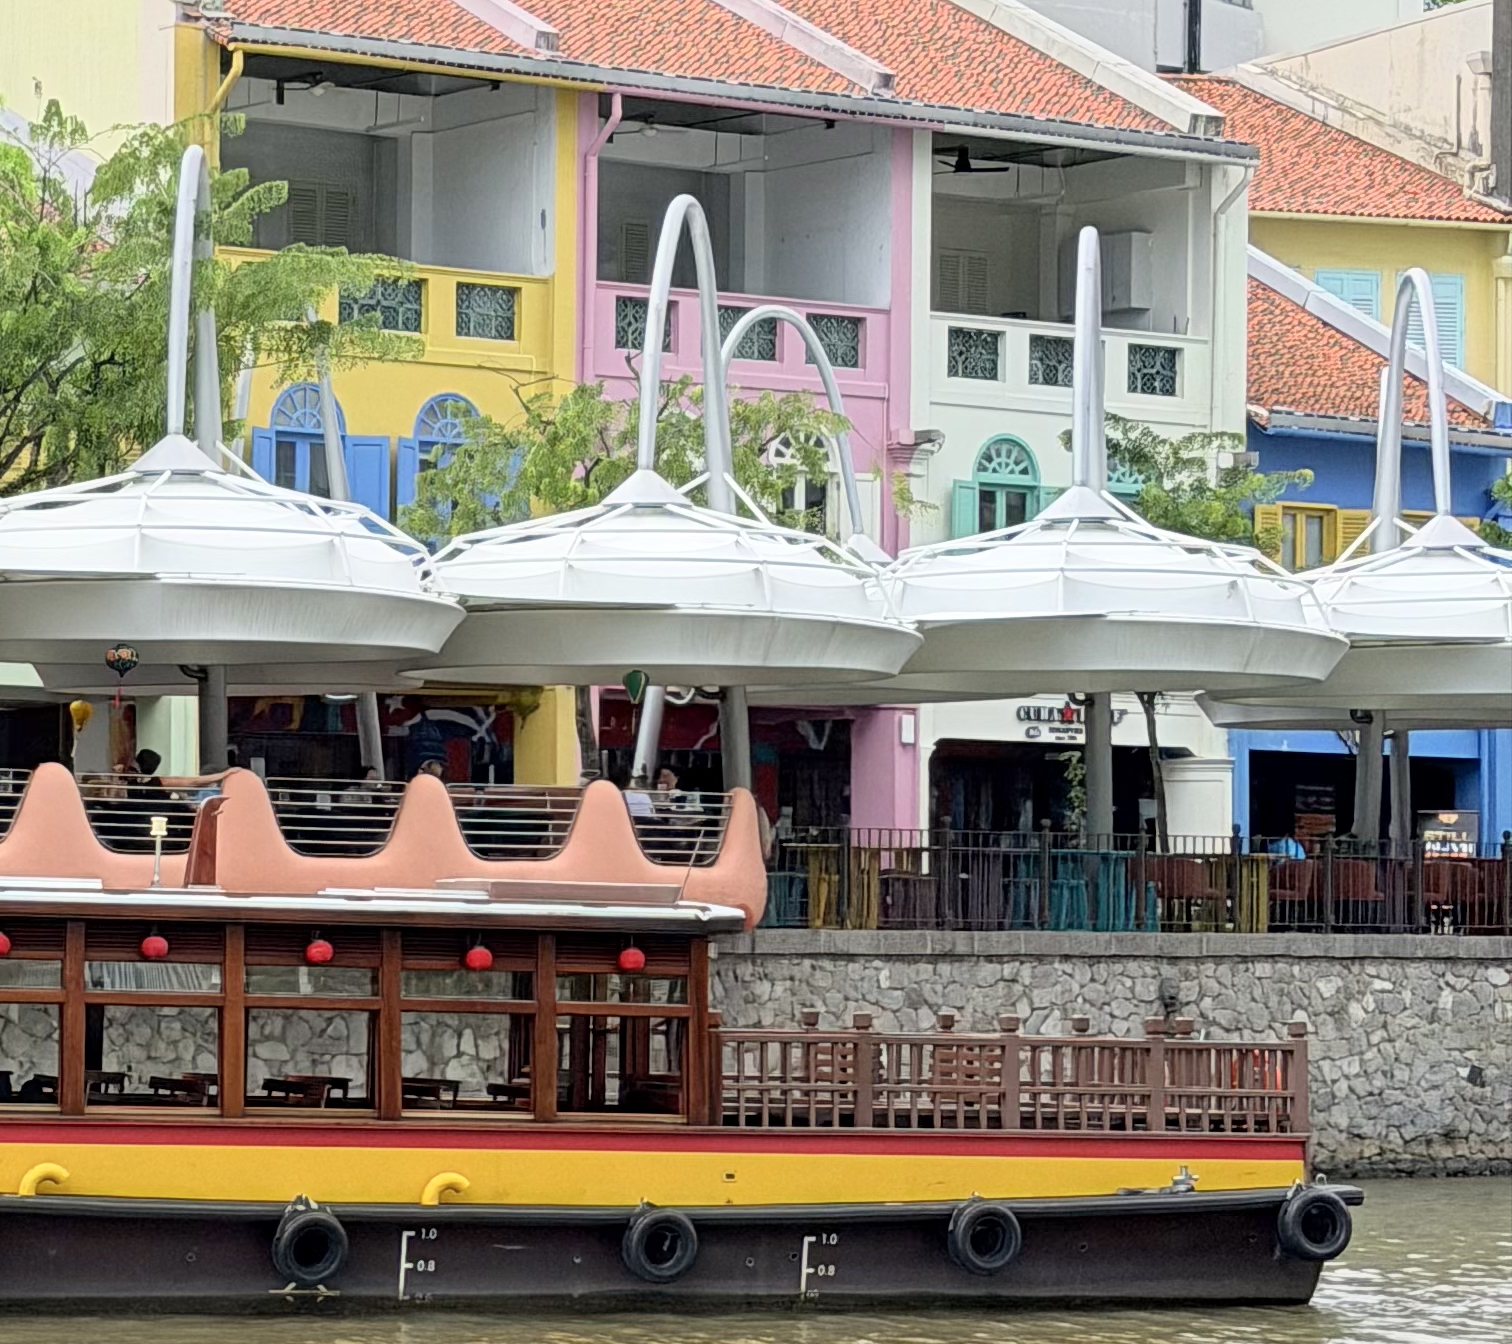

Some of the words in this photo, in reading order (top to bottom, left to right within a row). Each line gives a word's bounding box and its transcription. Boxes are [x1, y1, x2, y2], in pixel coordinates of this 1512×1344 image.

[421, 1227, 438, 1240] 1.0
[822, 1232, 838, 1245] 1.0
[416, 1259, 436, 1272] 0.8
[817, 1264, 836, 1277] 0.8
